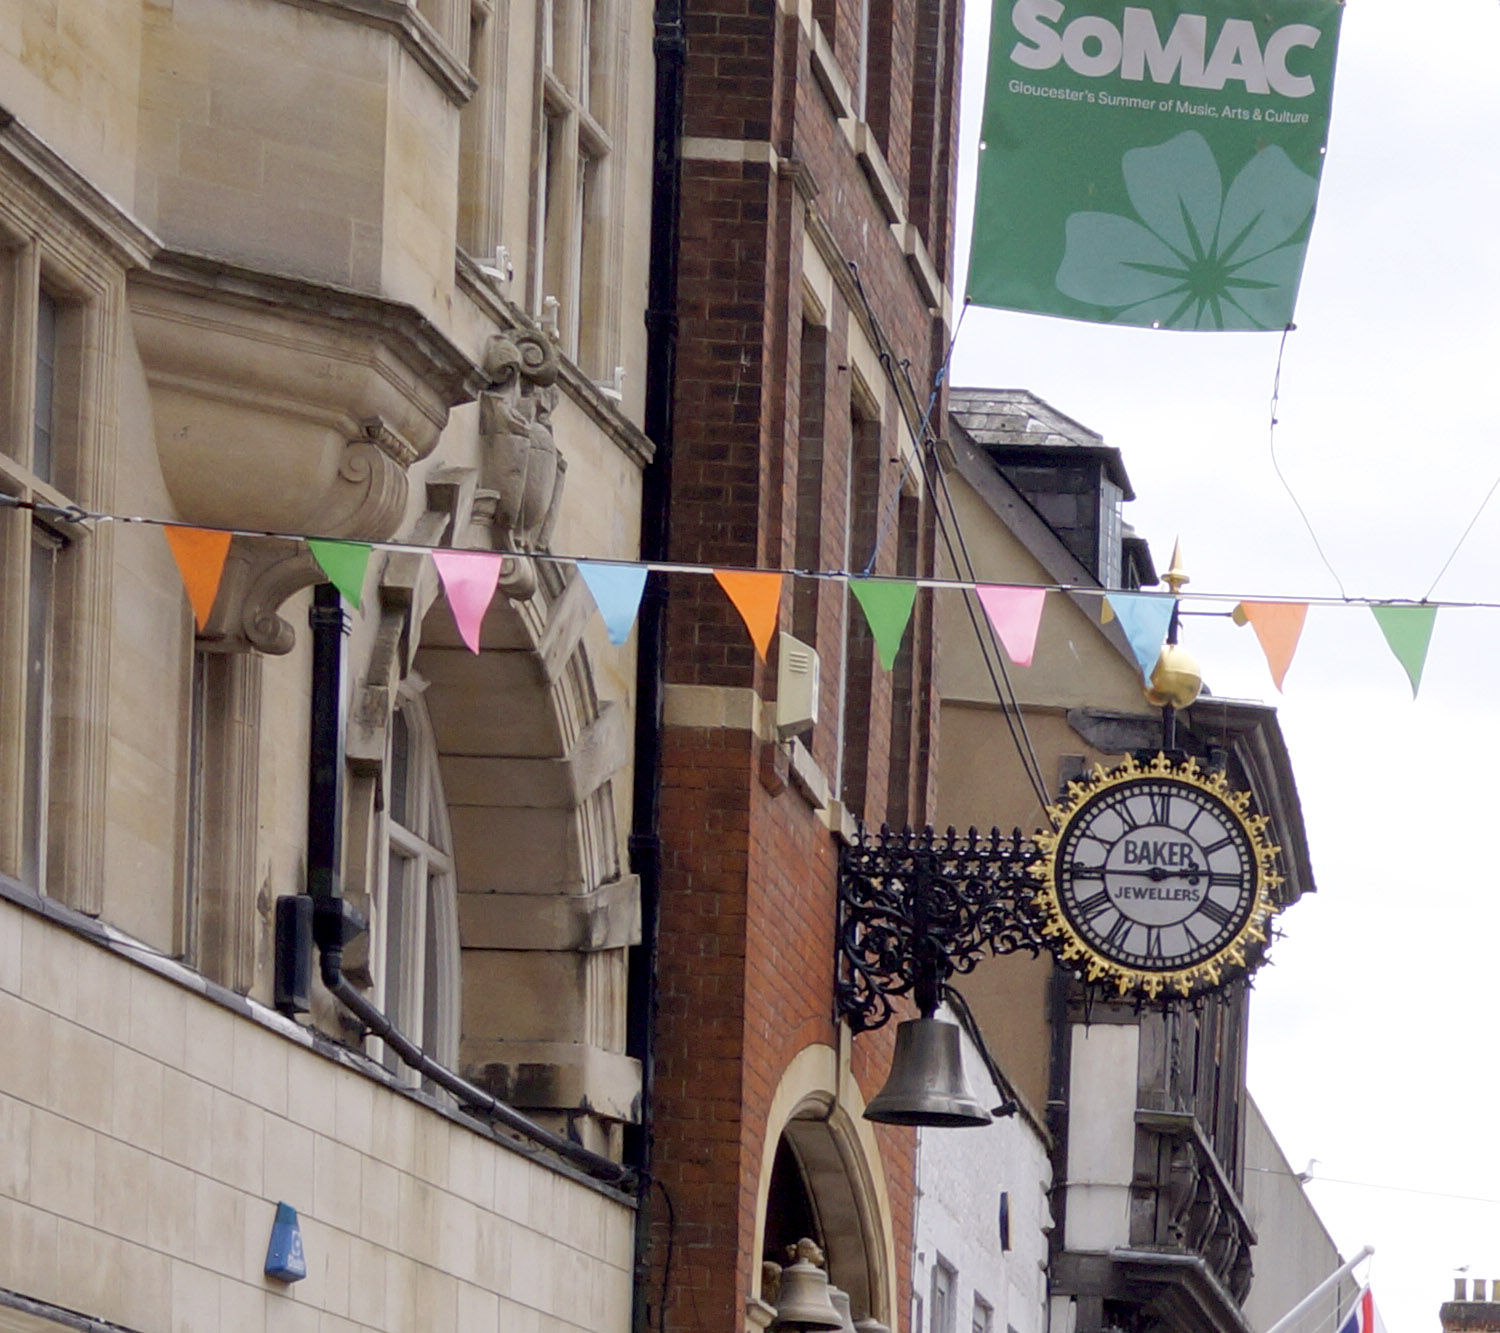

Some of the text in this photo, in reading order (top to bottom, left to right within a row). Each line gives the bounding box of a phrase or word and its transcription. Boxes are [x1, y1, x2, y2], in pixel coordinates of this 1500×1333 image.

[1010, 0, 1321, 98] SoMAC
[1008, 79, 1310, 124] Gloucester's Summer of Music, Arts & Culture
[1124, 839, 1194, 867] BAKER
[1114, 885, 1200, 902] JEWELLERS
